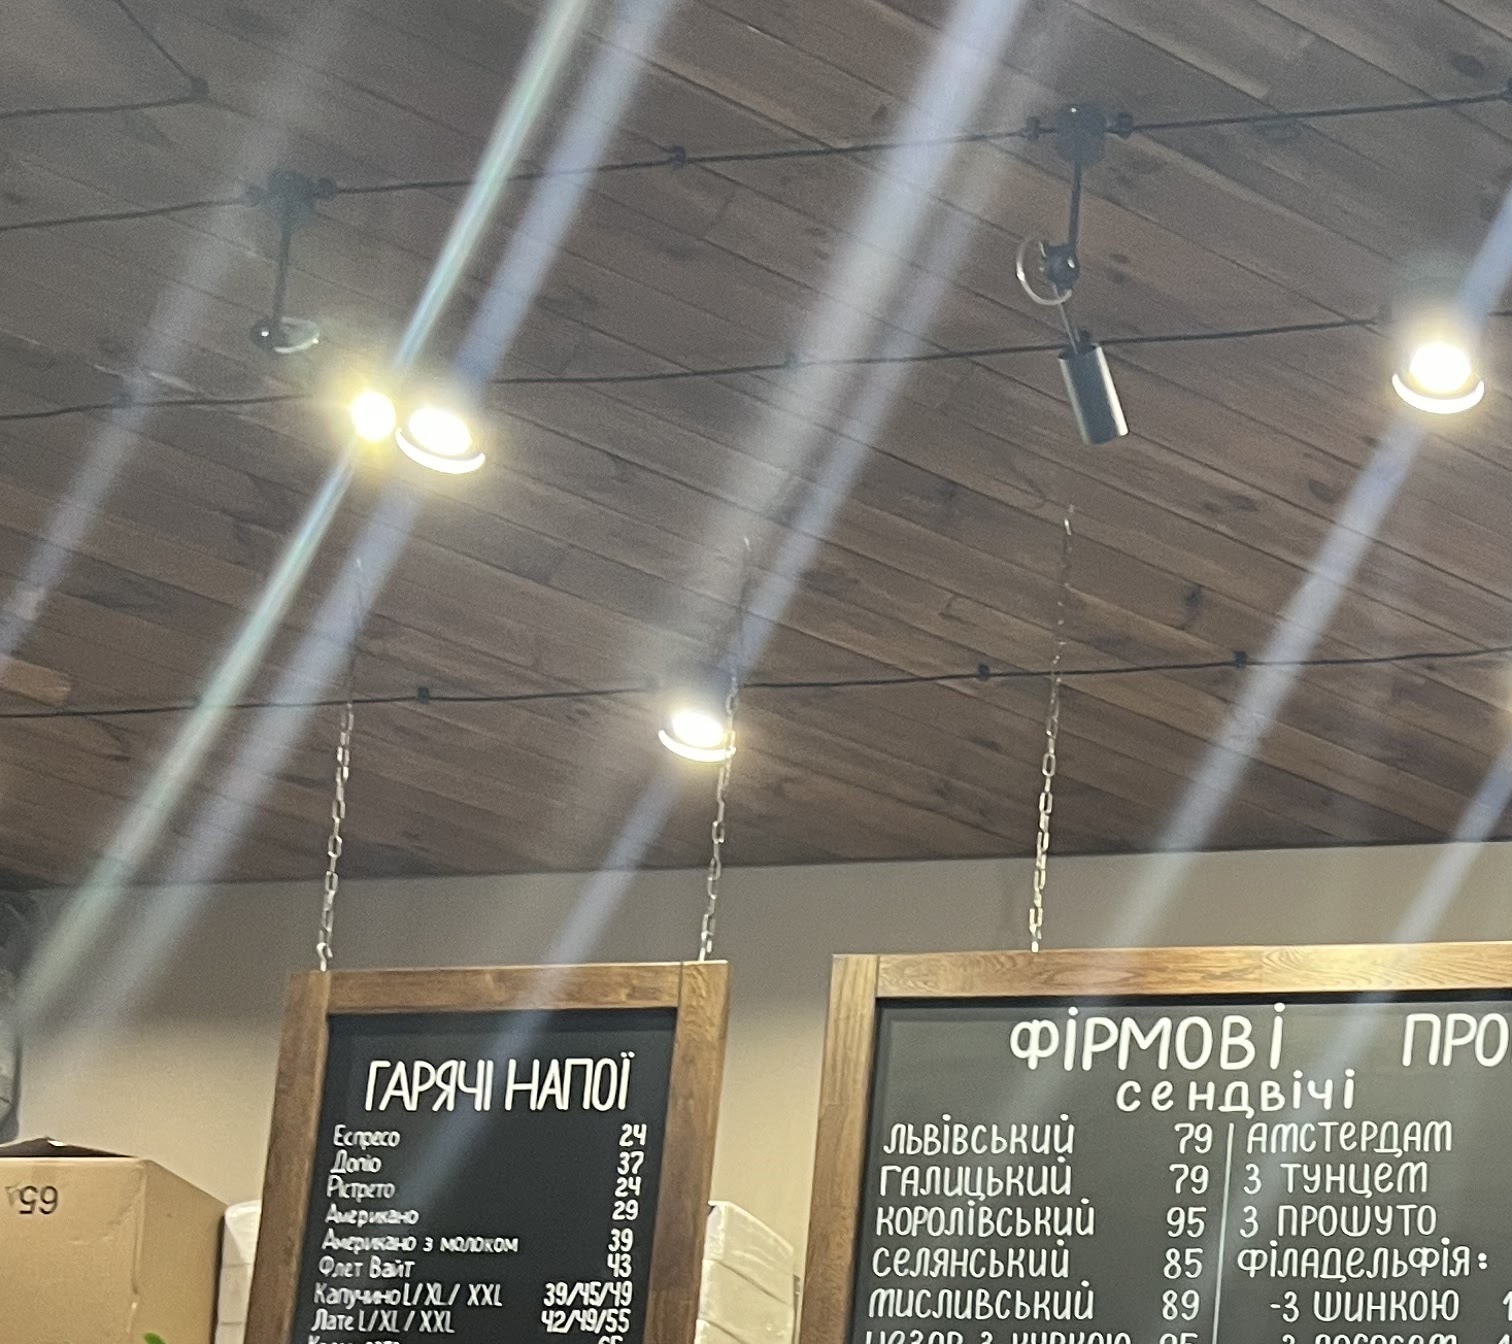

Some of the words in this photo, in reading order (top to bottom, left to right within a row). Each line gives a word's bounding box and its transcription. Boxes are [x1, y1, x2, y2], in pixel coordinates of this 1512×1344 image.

[1010, 1003, 1285, 1071] ФІРМОВІ
[366, 1060, 493, 1111] ГАРЯЧІ
[505, 1052, 635, 1111] НАПОЇ
[1117, 1069, 1355, 1119] сендвічі
[334, 1125, 400, 1150] Еспресо
[619, 1124, 646, 1146] 24
[884, 1114, 1074, 1155] ЛЬВІВСЬКИЙ
[1247, 1121, 1451, 1157] АМСТЕРДАМ
[330, 1150, 381, 1173] Допіо
[881, 1156, 1071, 1201] ГАЛИЦЬКИЙ
[327, 1175, 395, 1202] Рістрето
[1280, 1162, 1427, 1198] ТУНЦЕМ
[326, 1204, 419, 1227] Американо
[877, 1198, 1094, 1237] КОРОЛІВСЬКИЙ
[1278, 1205, 1436, 1236] ПРОШУТО
[322, 1228, 416, 1254] Американо
[440, 1237, 518, 1252] молоком
[873, 1239, 1068, 1278] СЕЛЯНСЬКИЙ
[319, 1256, 363, 1277] Флет
[370, 1255, 415, 1278] Вайт
[1238, 1237, 1487, 1283] ФІЛАДЕЛЬФІЯ:
[544, 1281, 632, 1306] 39/45/49
[869, 1280, 1093, 1320] МИСЛИВСЬКИЙ
[1314, 1290, 1459, 1322] ШИНКОЮ
[311, 1309, 354, 1331] Лате
[542, 1308, 631, 1334] 42/49/55
